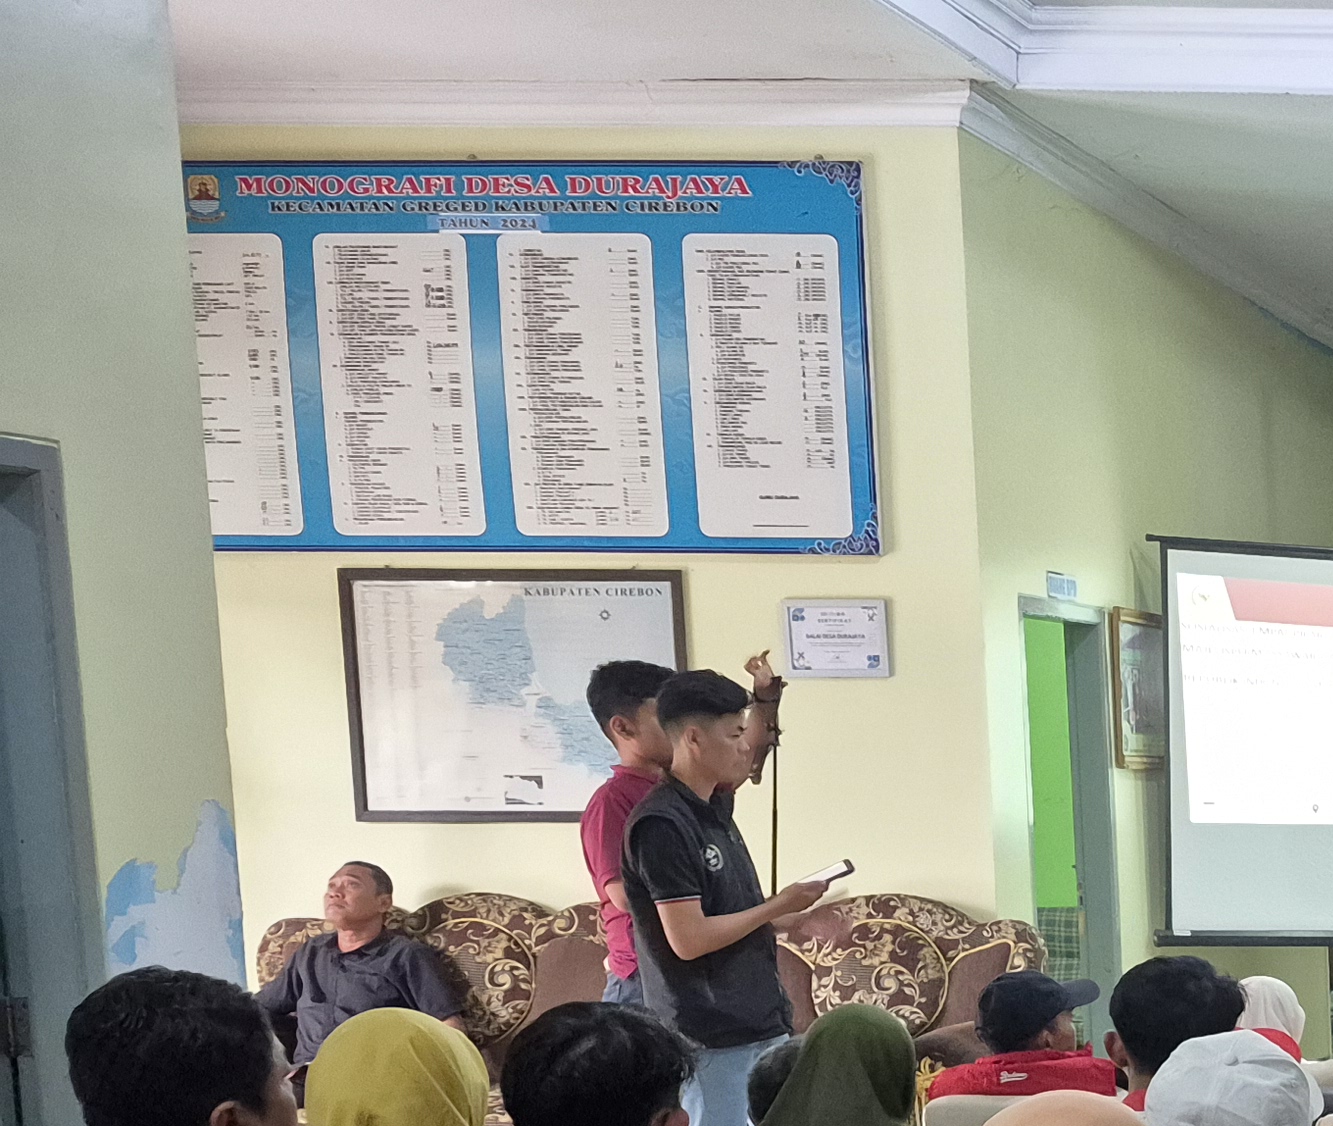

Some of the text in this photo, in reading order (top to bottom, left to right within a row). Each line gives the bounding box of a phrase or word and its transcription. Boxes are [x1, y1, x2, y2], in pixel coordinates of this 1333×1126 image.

[237, 175, 751, 201] MONOGRAFI DESA DURAJAYA
[269, 200, 720, 213] KECAMATAN GREGED KABUPATEN CIREBON
[438, 218, 489, 228] TAHUN
[524, 587, 662, 597] KABUPATEN CIREBON
